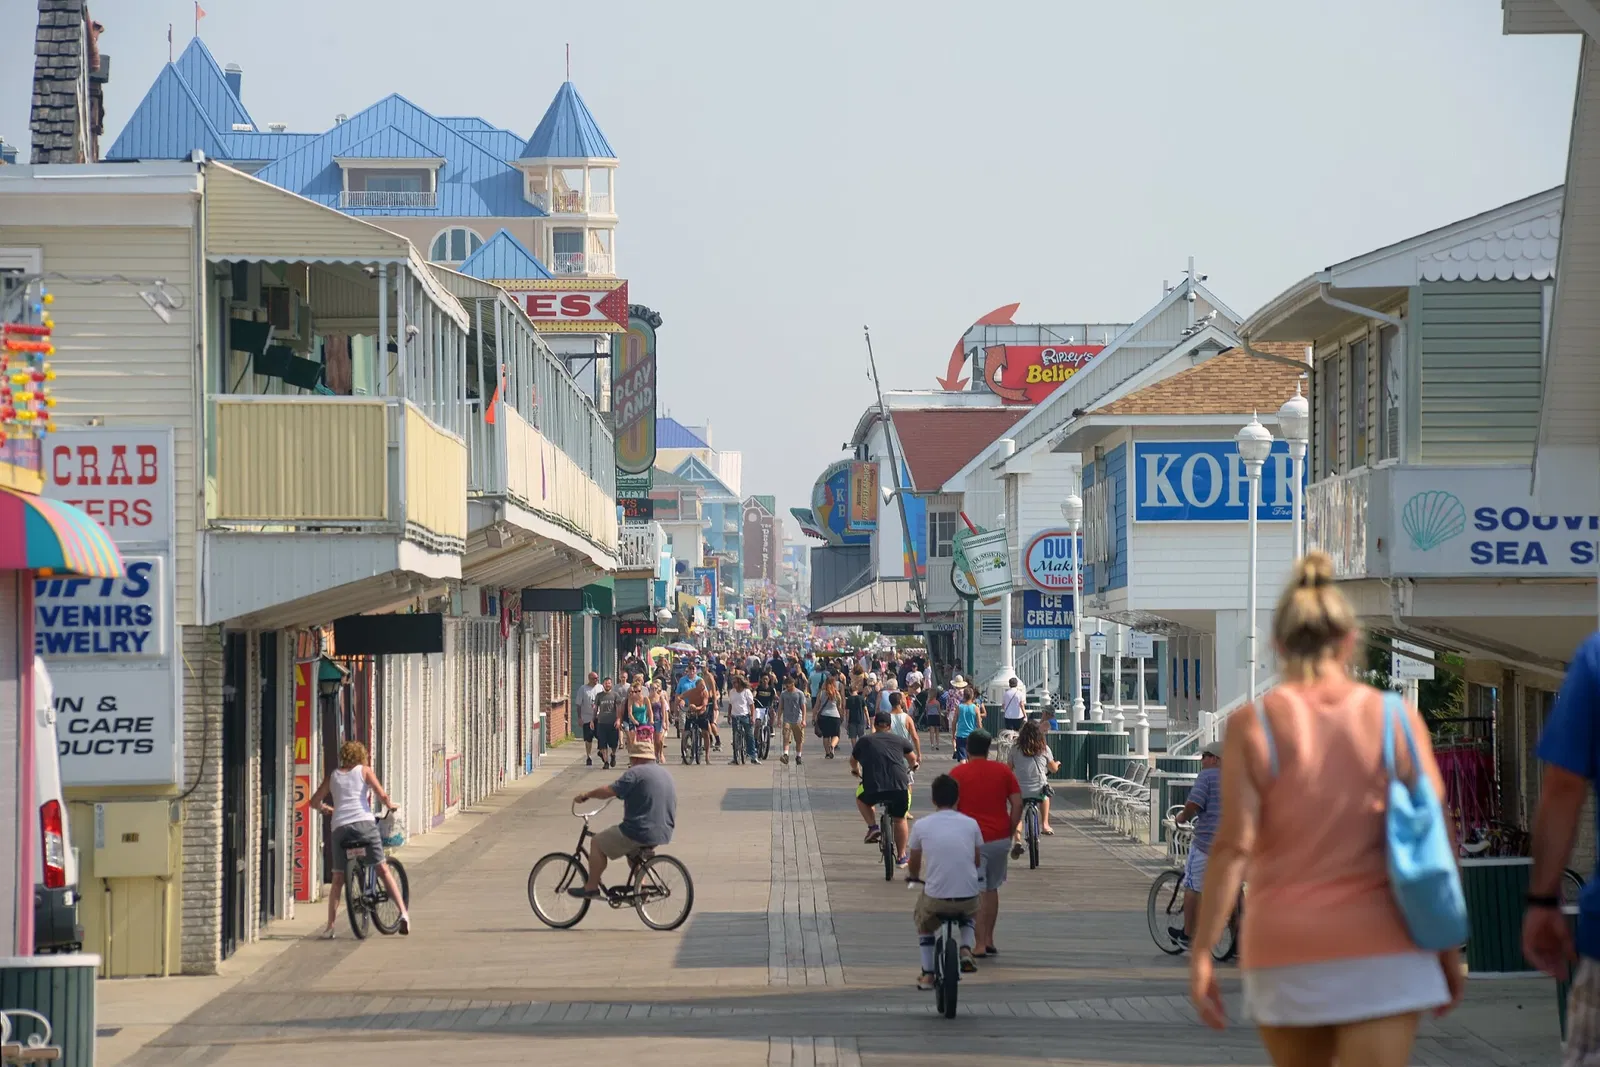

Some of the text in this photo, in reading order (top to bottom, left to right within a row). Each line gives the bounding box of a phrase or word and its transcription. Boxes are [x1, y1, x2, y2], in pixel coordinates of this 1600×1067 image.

[511, 294, 591, 317] ES
[615, 362, 651, 405] PLAY
[1026, 365, 1079, 384] Belie
[616, 387, 652, 429] LAND
[53, 445, 157, 485] CRAB
[1470, 541, 1599, 565] SEA S
[1044, 574, 1073, 585] Thick
[1041, 594, 1062, 608] ICE
[35, 604, 153, 627] VENIRS
[1027, 610, 1074, 625] CREAM
[937, 623, 963, 631] WOMEN
[97, 696, 118, 713] &
[68, 717, 154, 734] CARE
